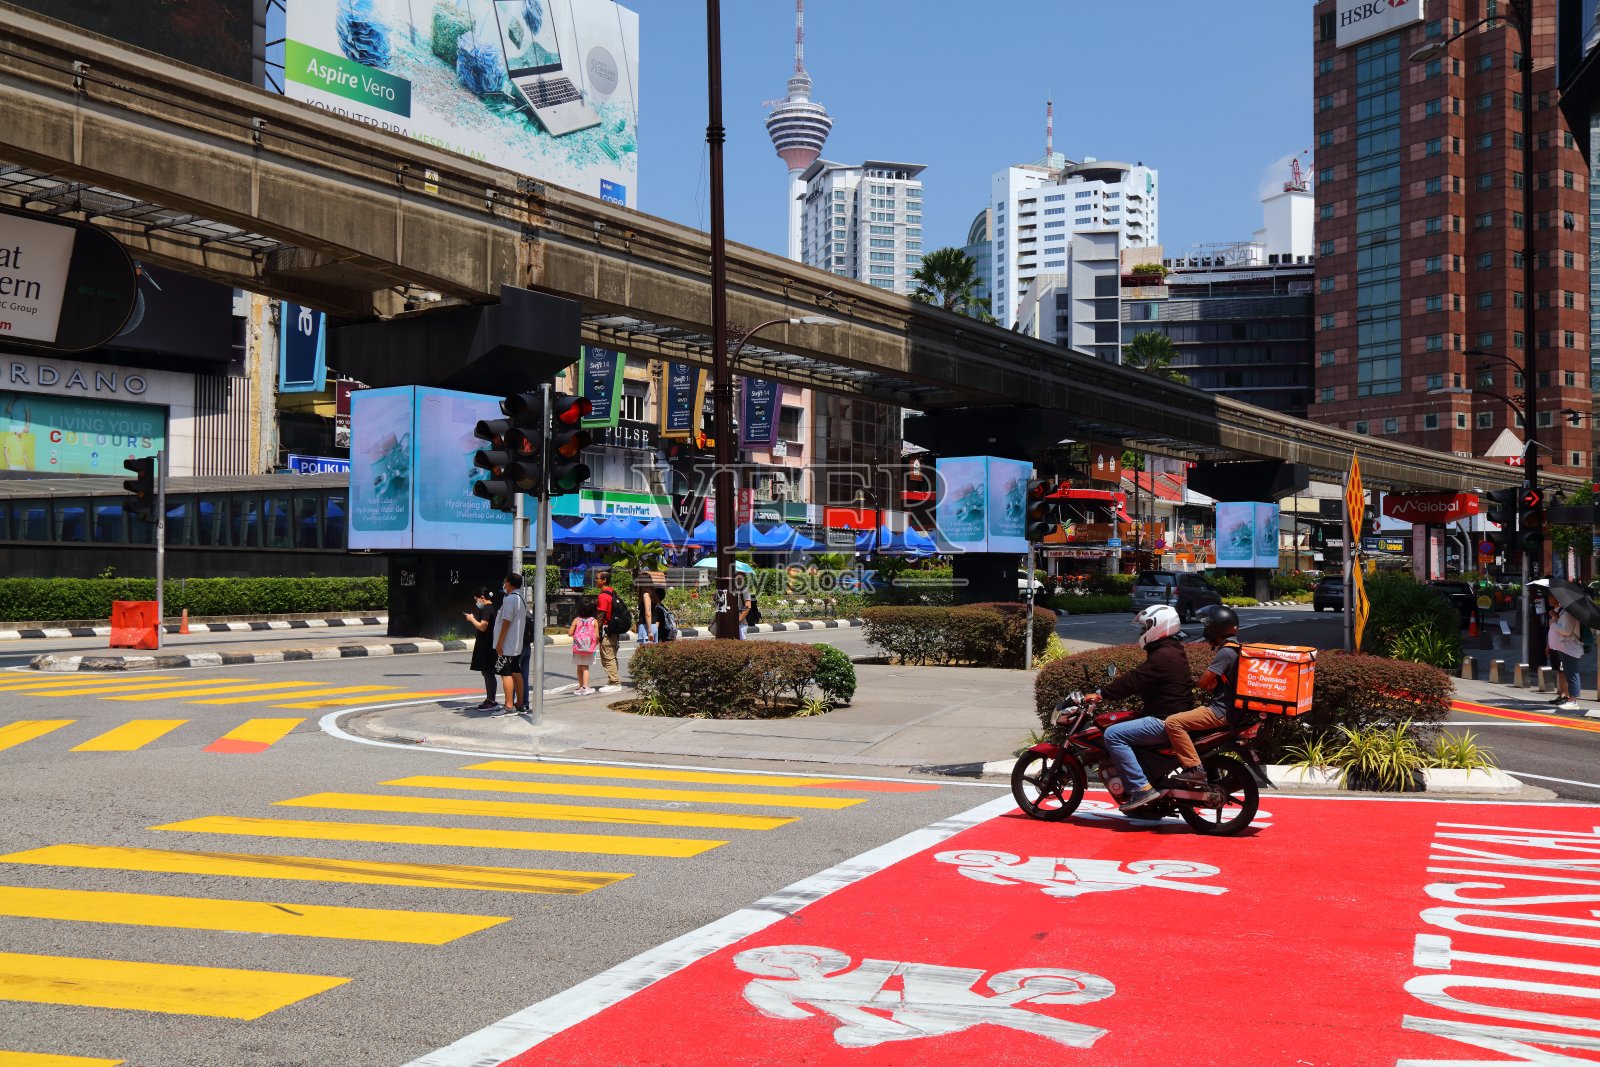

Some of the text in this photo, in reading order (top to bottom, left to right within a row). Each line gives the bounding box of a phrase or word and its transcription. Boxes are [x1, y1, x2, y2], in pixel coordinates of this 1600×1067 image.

[1340, 0, 1386, 27] HSBC
[306, 58, 395, 101] Aspire Vero
[10, 302, 38, 315] Group
[0, 362, 148, 395] RDANO
[50, 415, 153, 435] LIVING YOUR
[605, 426, 649, 442] PULSE
[50, 430, 153, 449] COLOURS
[616, 503, 650, 515] FamilyMart
[1417, 500, 1459, 512] Global
[1248, 658, 1289, 675] 24/7
